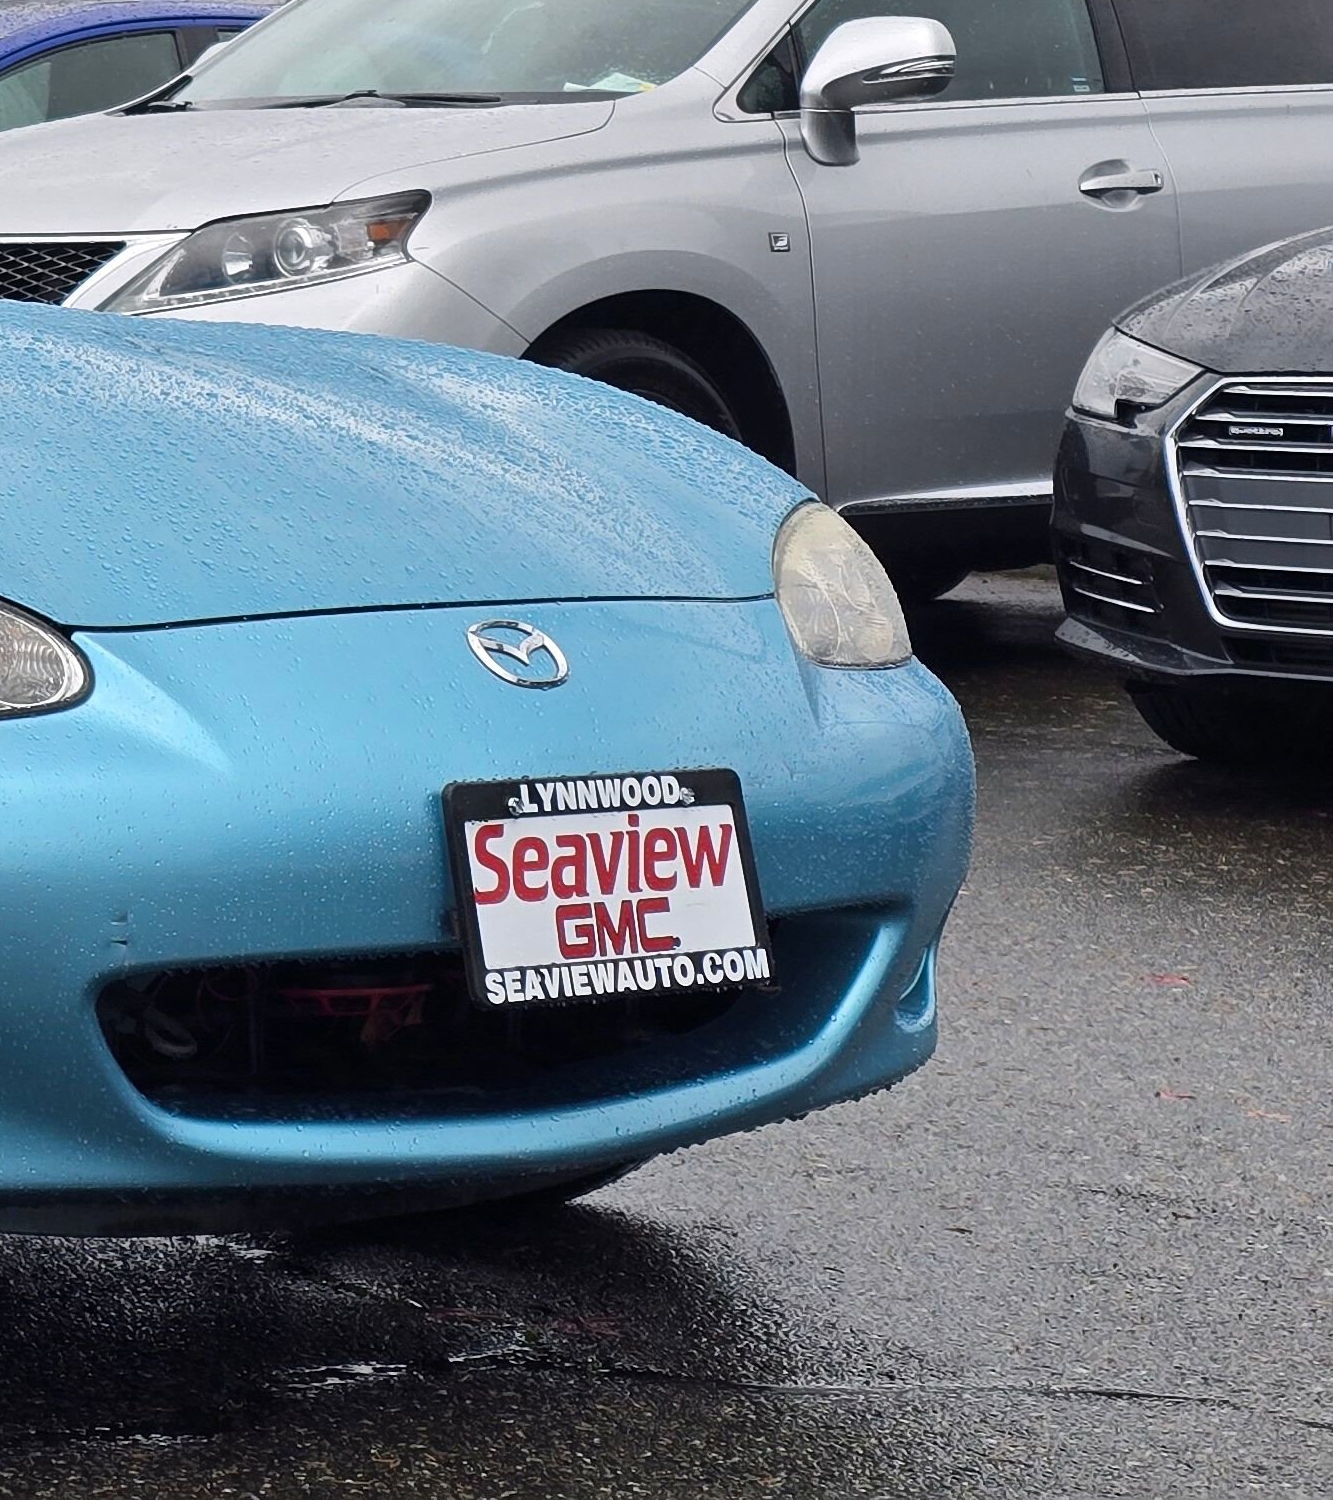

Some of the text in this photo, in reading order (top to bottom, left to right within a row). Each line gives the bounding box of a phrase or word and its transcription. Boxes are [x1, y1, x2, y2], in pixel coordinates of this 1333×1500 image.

[520, 776, 680, 812] LYNNWOOD
[474, 814, 733, 905] Seaview
[555, 897, 679, 959] GMC
[484, 948, 771, 1005] SEAVIEWAUTO.COM
